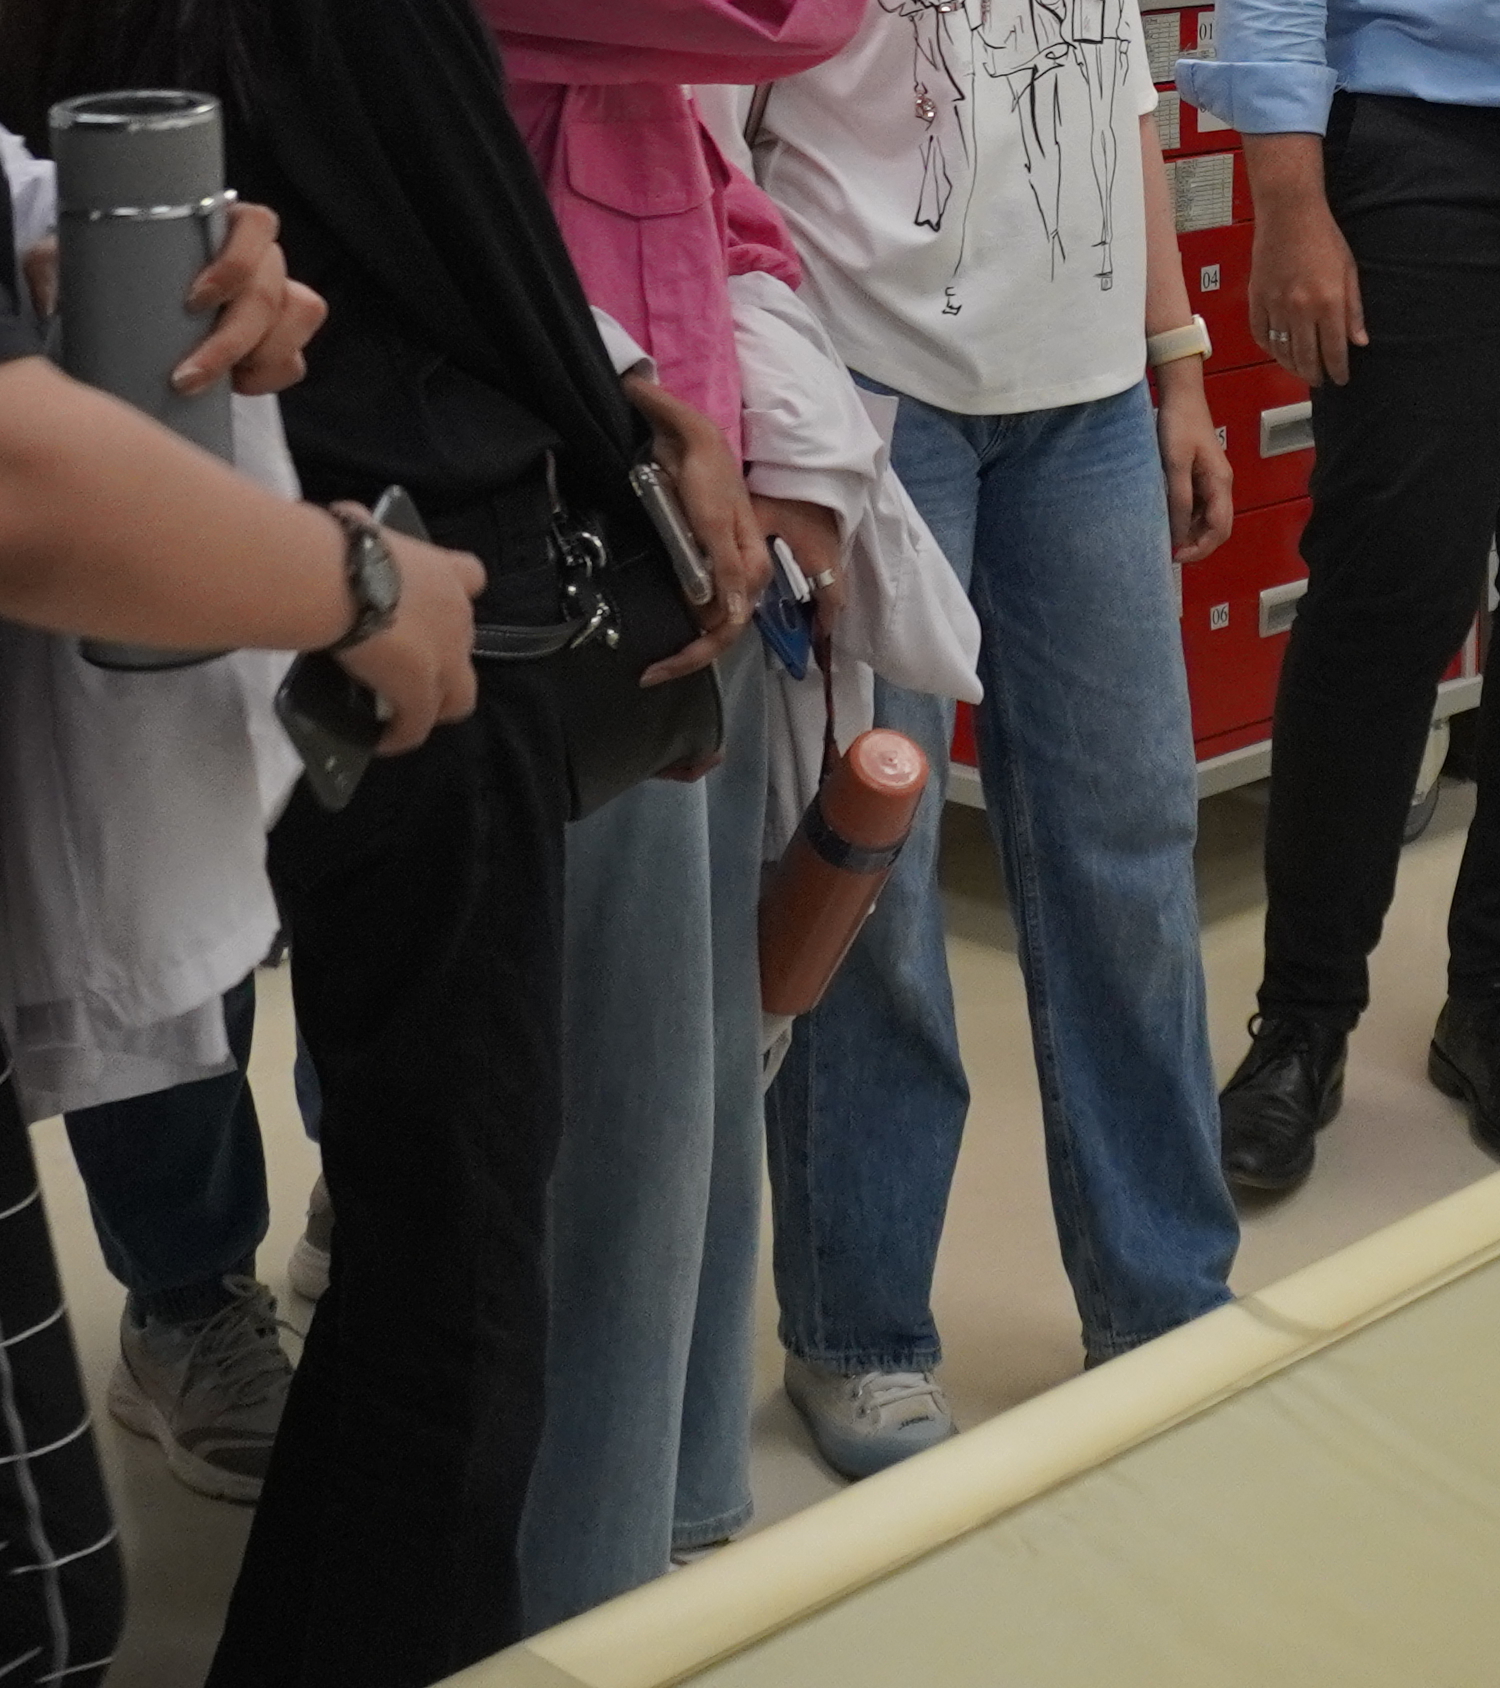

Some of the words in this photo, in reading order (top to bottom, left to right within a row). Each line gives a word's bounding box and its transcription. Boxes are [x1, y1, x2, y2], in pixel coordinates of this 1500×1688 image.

[1199, 22, 1214, 41] 01
[1202, 270, 1219, 290] 04
[1212, 605, 1228, 625] 06
